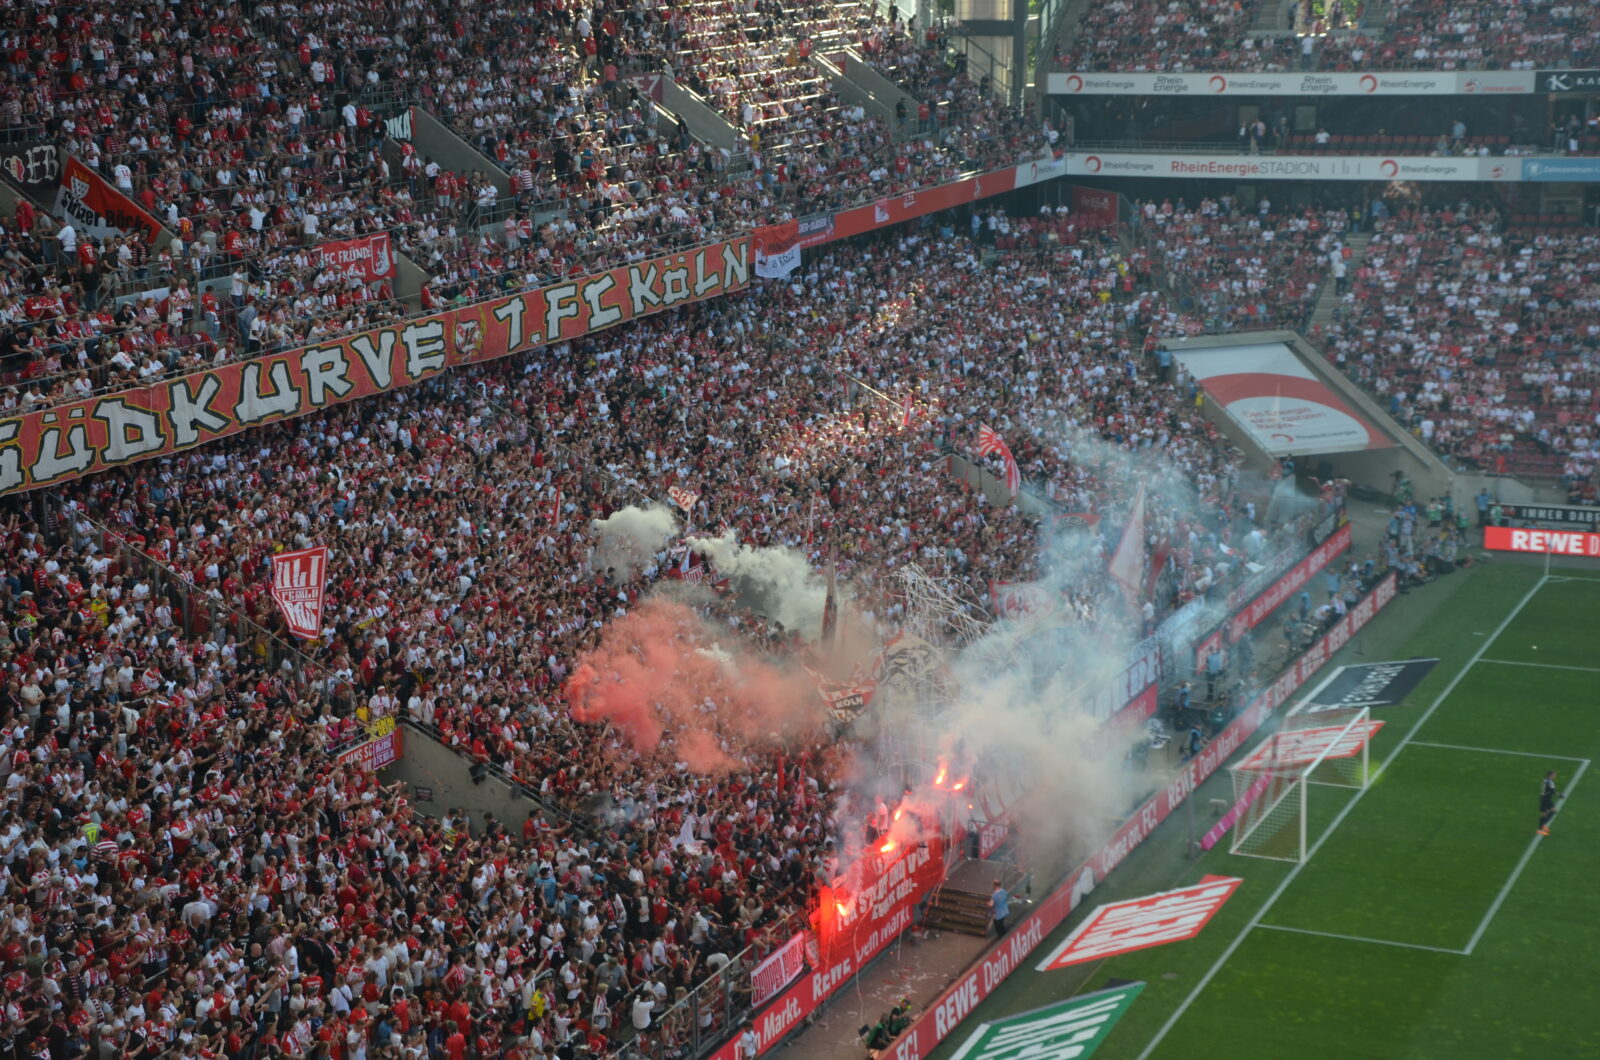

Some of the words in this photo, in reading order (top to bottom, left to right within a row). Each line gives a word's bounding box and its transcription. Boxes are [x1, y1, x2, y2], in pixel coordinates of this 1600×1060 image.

[1085, 79, 1135, 89] RheinEnergie
[1157, 76, 1183, 84] Rhein
[1229, 80, 1281, 90] RheinEnergie
[1304, 76, 1332, 84] Rhein
[1381, 80, 1436, 90] RheinEnergie
[1153, 83, 1188, 92] Energie
[1301, 83, 1338, 93] Energie
[1103, 160, 1154, 171] RheinEnergie
[1401, 165, 1457, 175] RheinEnergie
[628, 242, 748, 318] KÖLN
[1522, 508, 1563, 521] IMMER
[1512, 530, 1585, 554] REWE
[1167, 762, 1198, 810] REWE
[1200, 749, 1217, 780] Dein
[1217, 729, 1239, 764] Markt
[1102, 838, 1128, 874] Come
[1129, 825, 1142, 848] on,
[1142, 799, 1158, 834] FC!
[813, 958, 851, 1001] REWE
[935, 973, 980, 1041] REWE
[983, 951, 1009, 992] Dein
[1010, 917, 1043, 967] Markt
[763, 997, 801, 1045] Markt.
